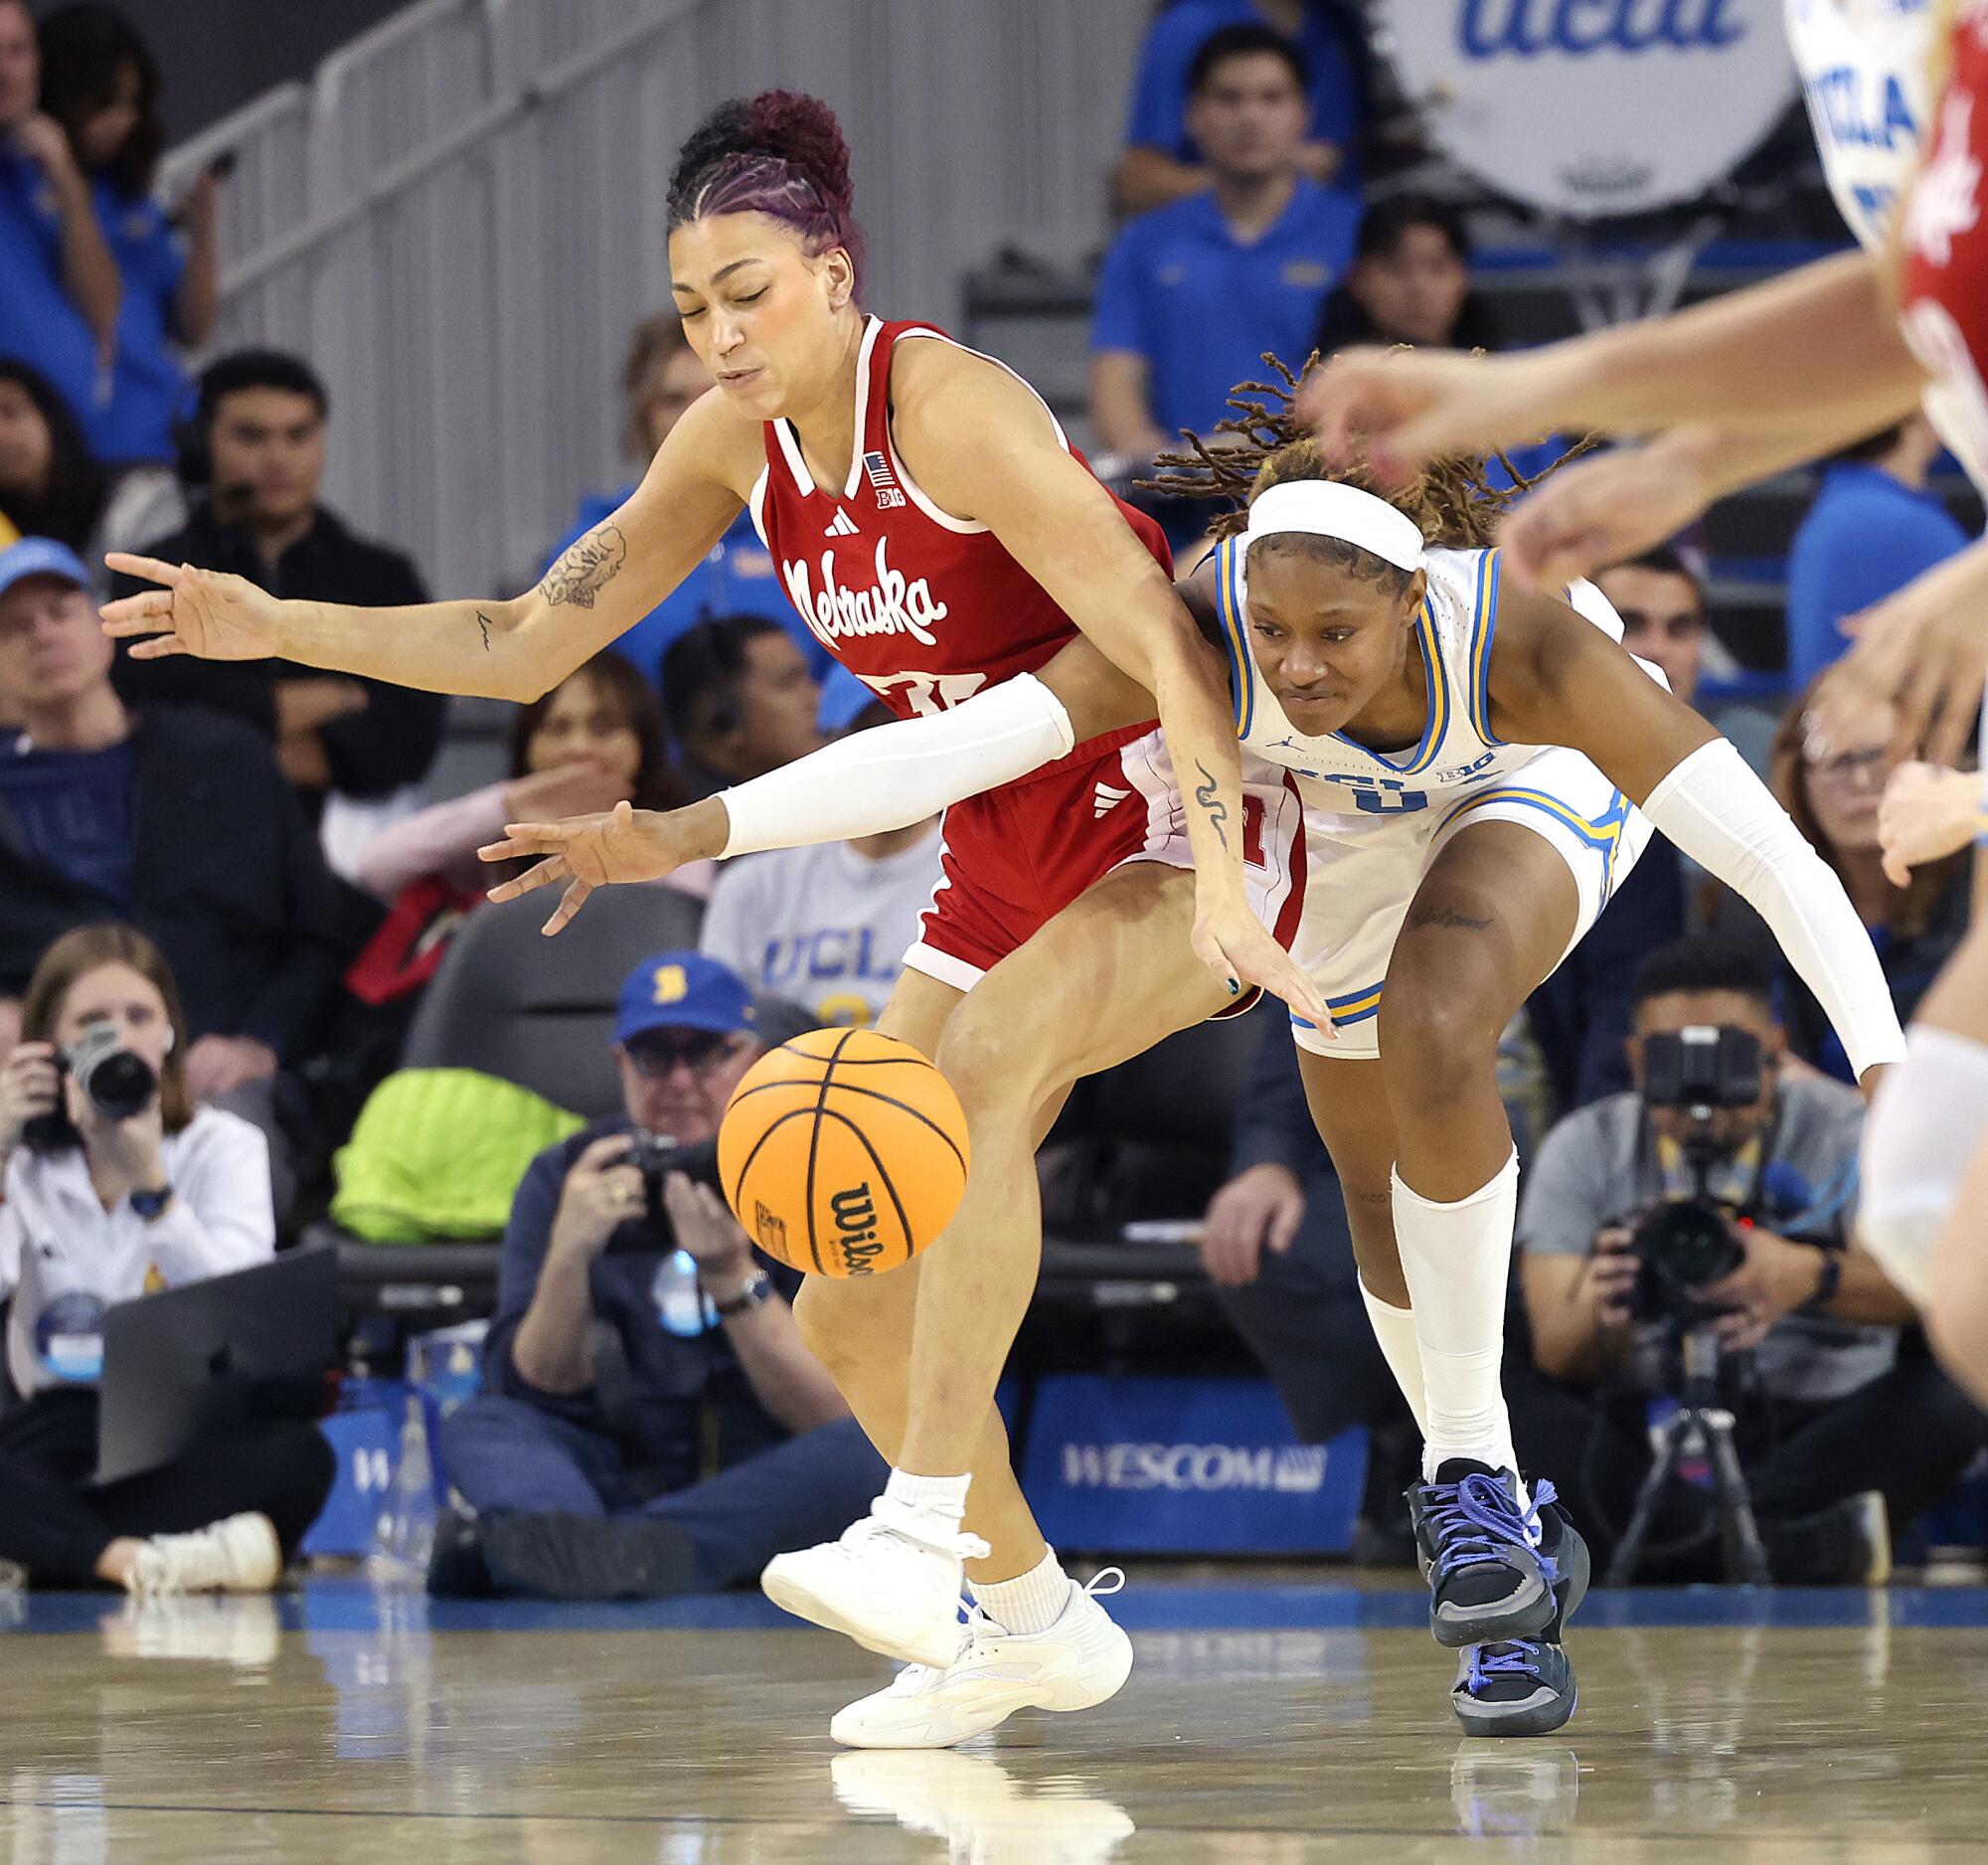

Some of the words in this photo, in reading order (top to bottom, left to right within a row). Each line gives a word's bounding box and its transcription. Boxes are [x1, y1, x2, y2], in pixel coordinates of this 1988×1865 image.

[783, 535, 948, 651] Nebraska
[761, 928, 897, 986] UCL
[1062, 1441, 1271, 1489] WESCOM
